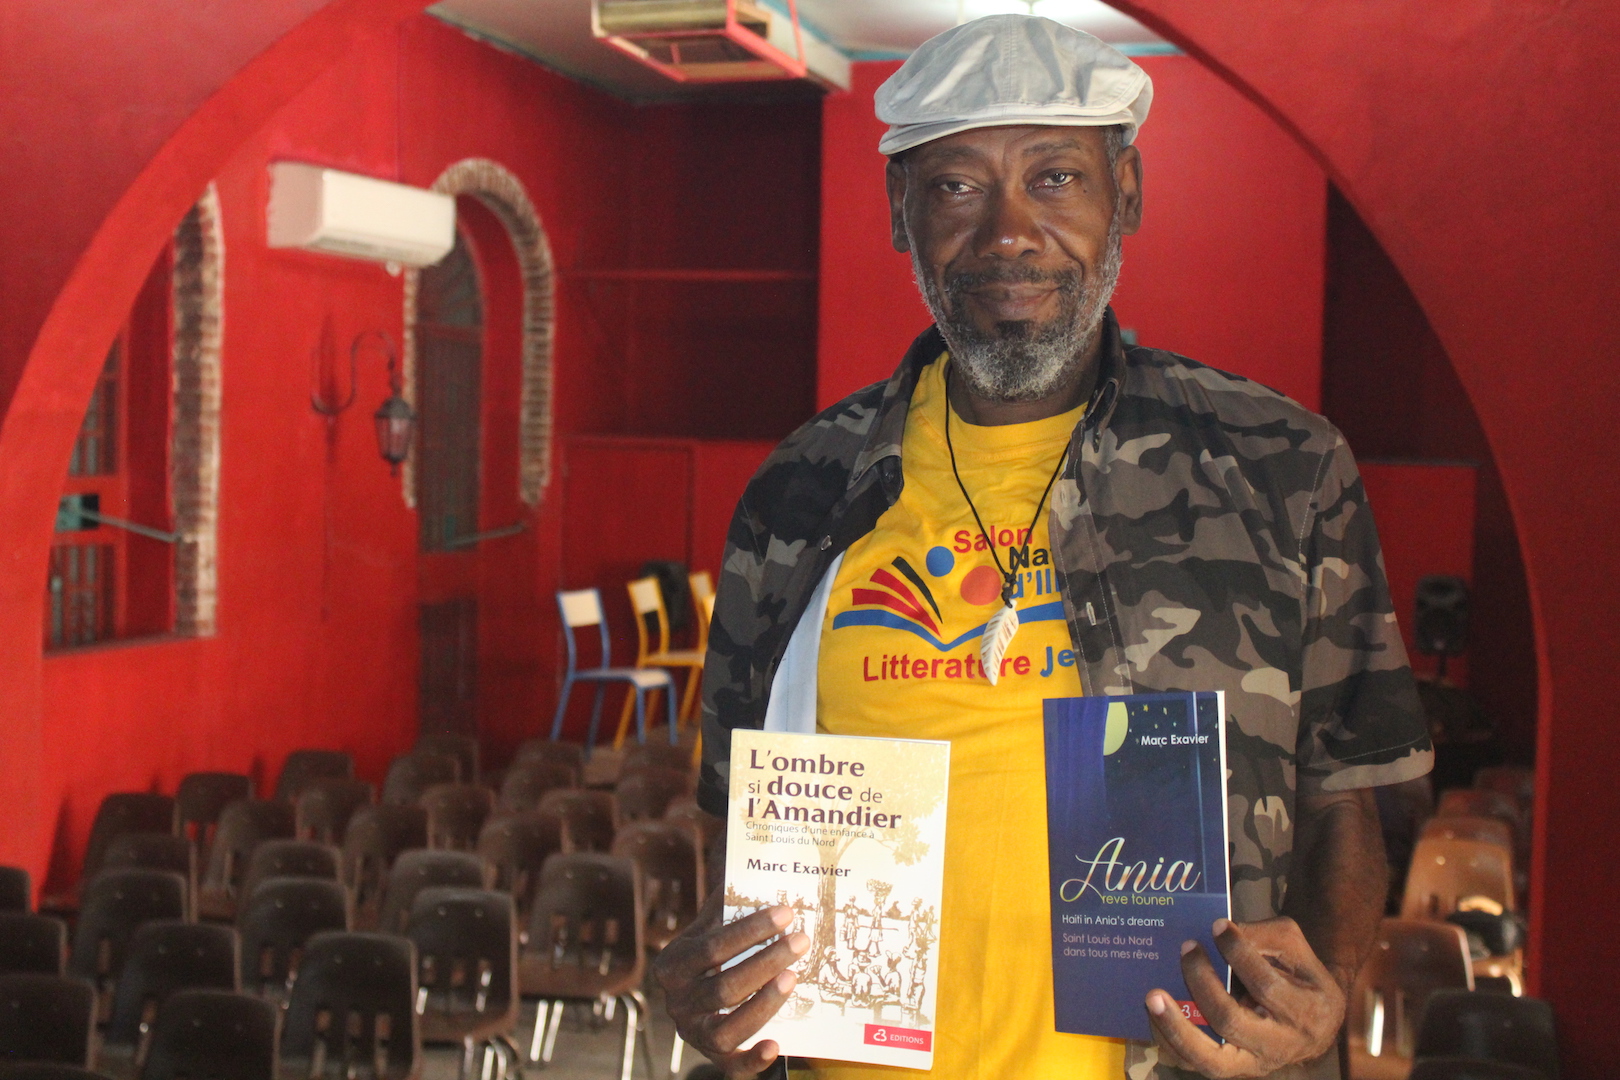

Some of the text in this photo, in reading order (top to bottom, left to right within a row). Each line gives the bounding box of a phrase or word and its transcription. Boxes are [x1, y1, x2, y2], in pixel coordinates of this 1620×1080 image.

[953, 525, 1033, 553] Salon
[1009, 545, 1052, 570] Na
[1141, 733, 1209, 746] Marc Exavier
[750, 749, 865, 777] L'ombre
[748, 775, 883, 803] si douce de
[747, 797, 902, 829] l'Amandier
[745, 821, 875, 839] Chroniques d'une enfance à
[745, 833, 835, 847] Saint Louis du Nord
[747, 858, 851, 877] Marc Exavier
[1060, 837, 1201, 902] Ania
[1102, 893, 1174, 906] reve tounen
[1062, 914, 1165, 927] Haiti in Ania's dreams
[1062, 932, 1153, 947] Saint Louis du Nord
[1063, 946, 1159, 960] dans tous mes rêves
[889, 1034, 924, 1045] EDITIONS
